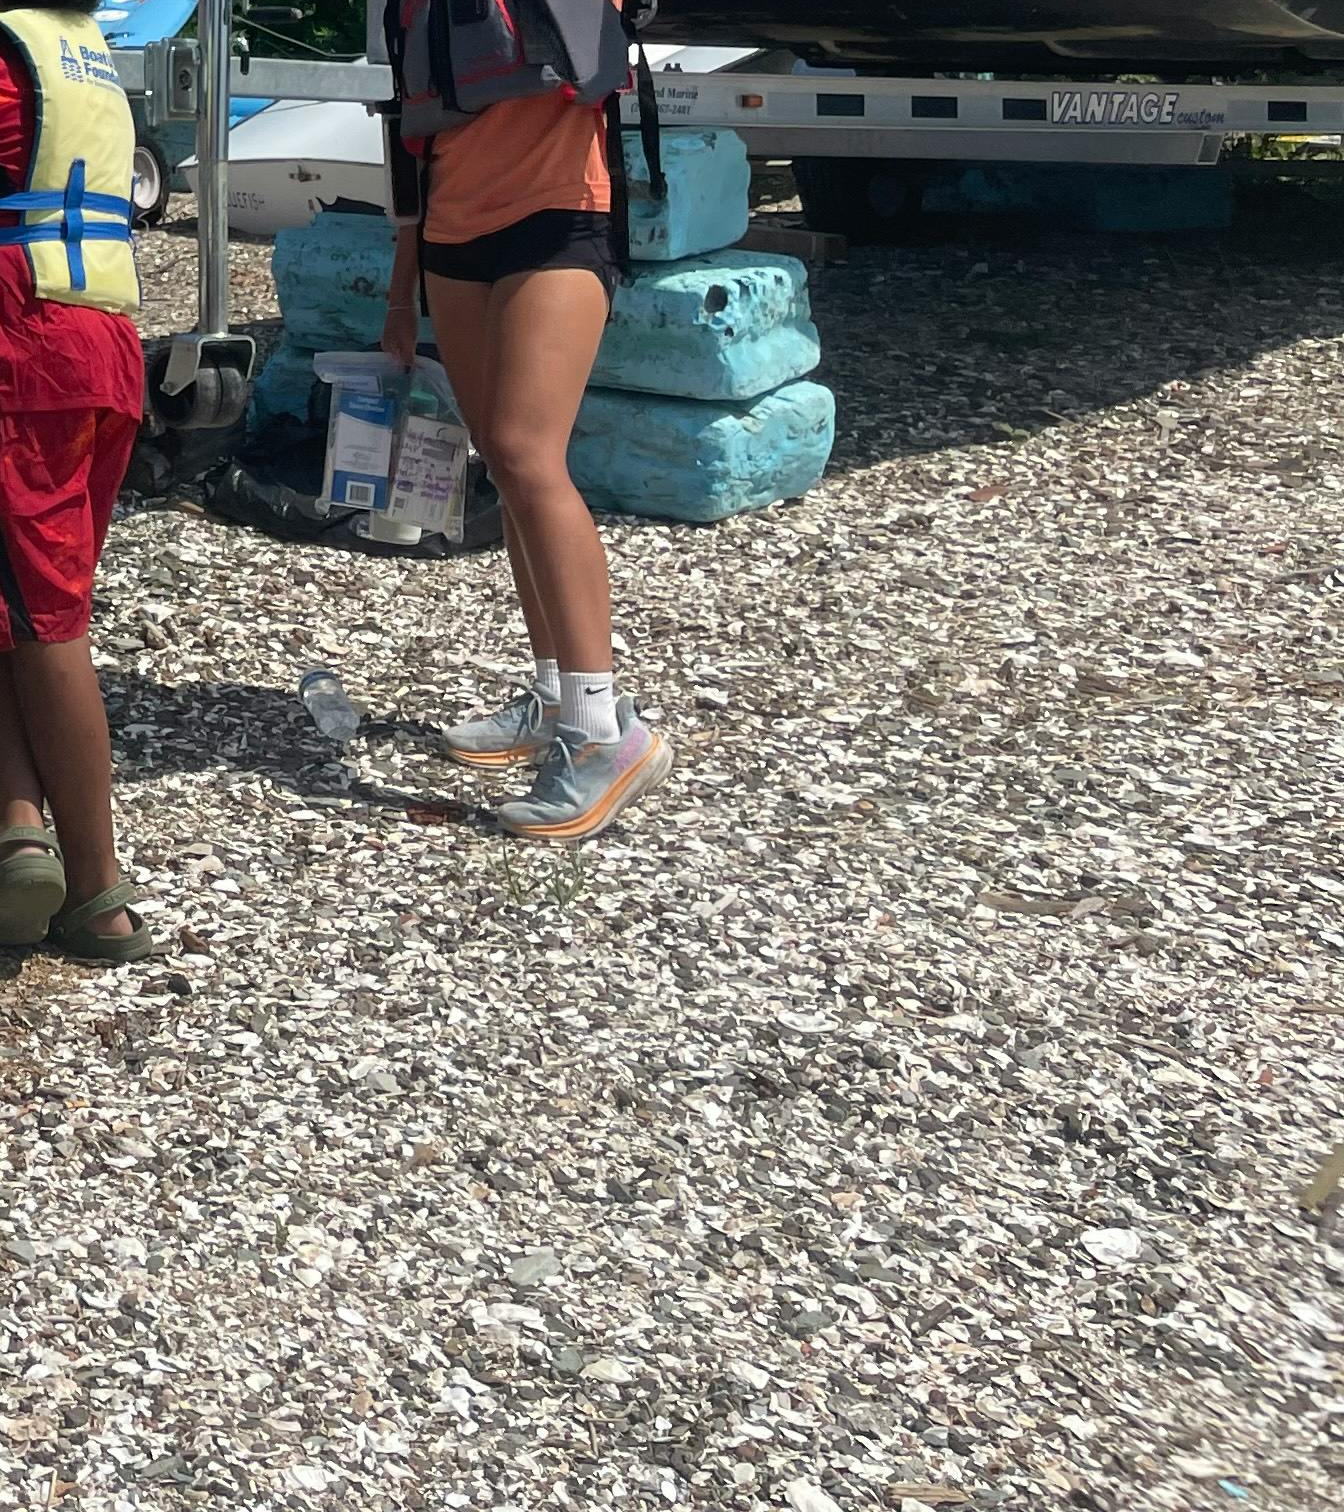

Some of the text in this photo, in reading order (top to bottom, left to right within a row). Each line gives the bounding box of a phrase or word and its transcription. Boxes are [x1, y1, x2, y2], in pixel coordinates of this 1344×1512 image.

[668, 87, 699, 99] Marine
[1051, 90, 1225, 126] VANTAGE custom
